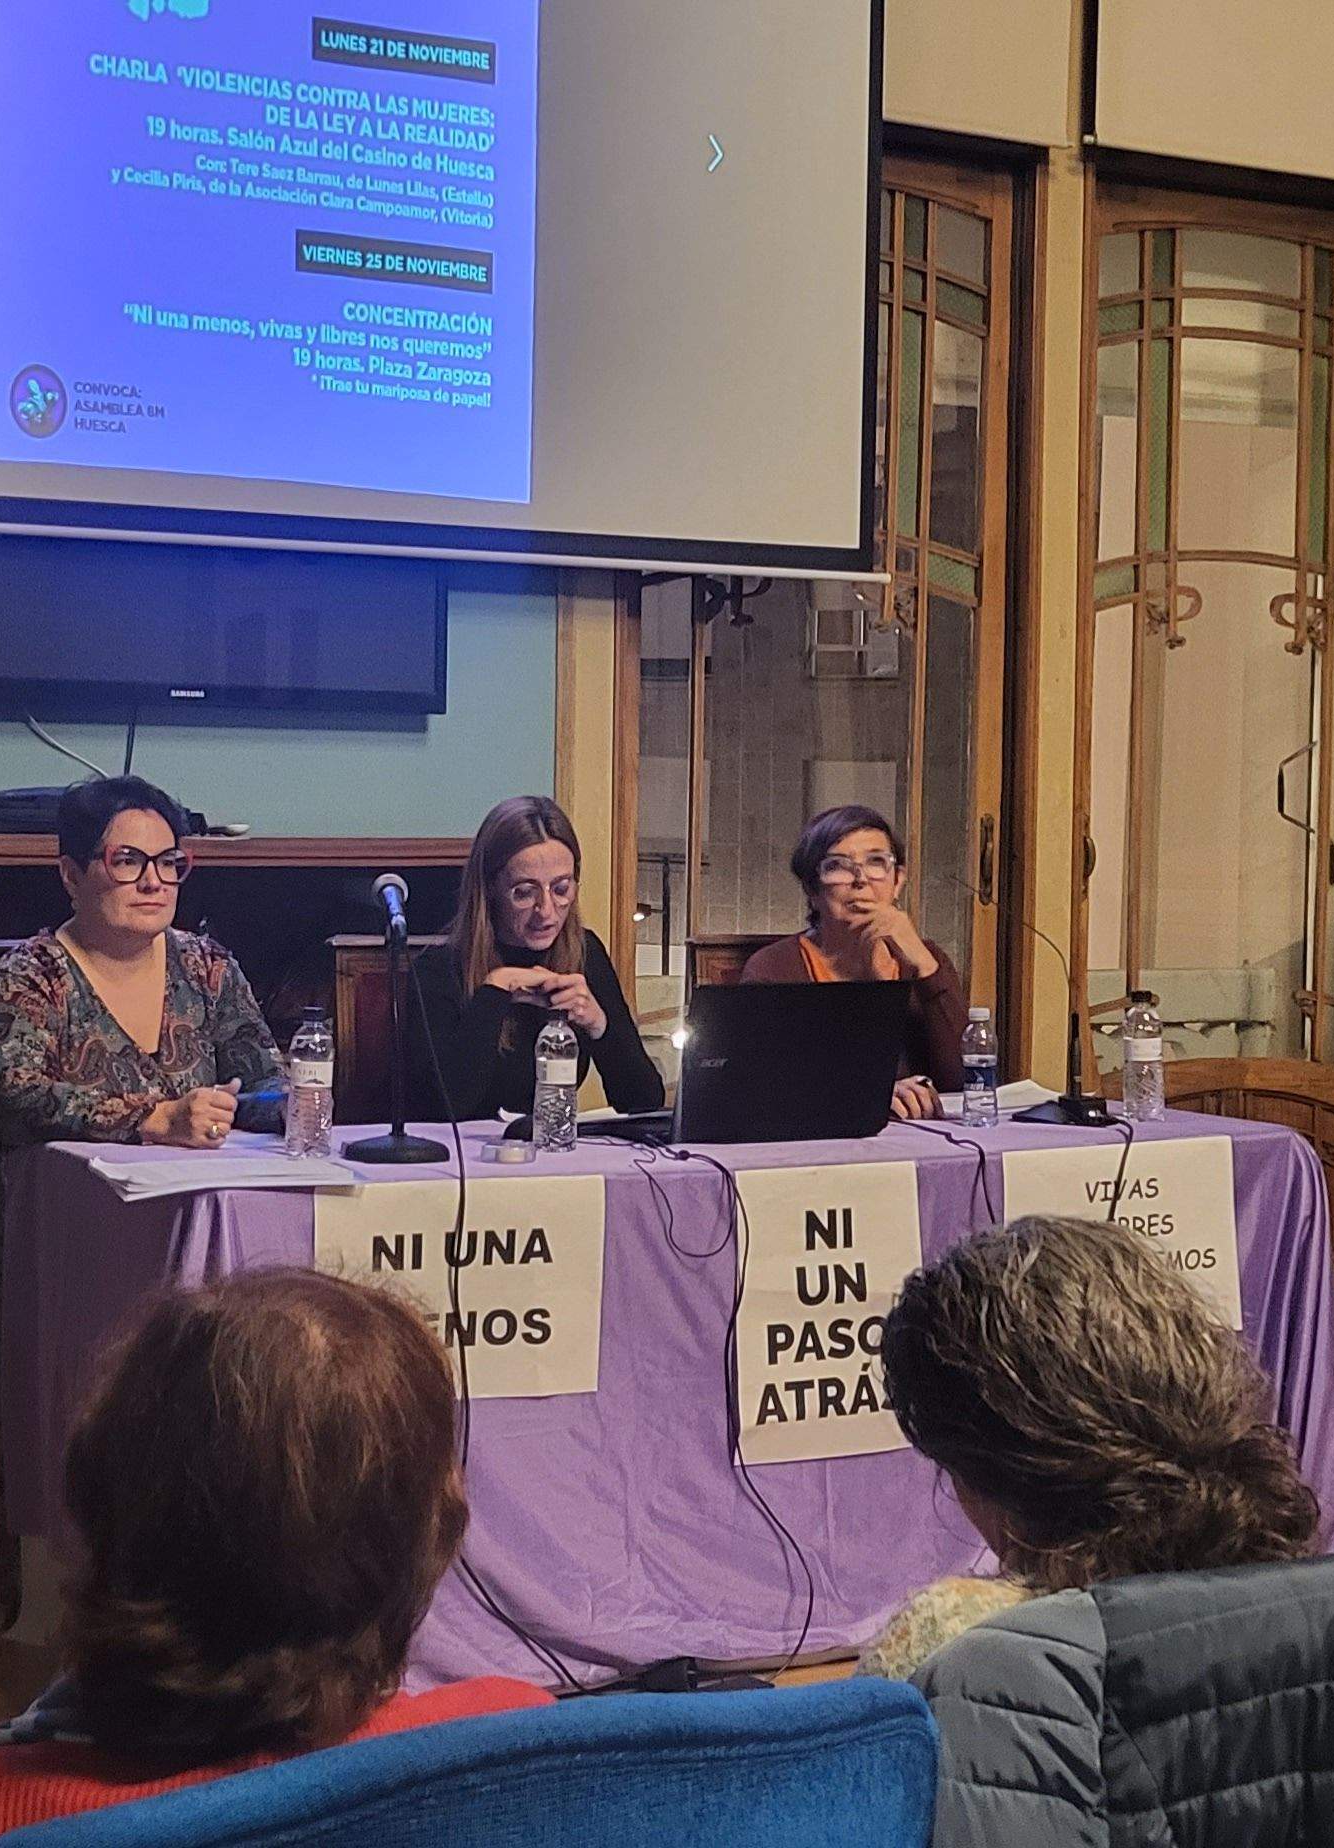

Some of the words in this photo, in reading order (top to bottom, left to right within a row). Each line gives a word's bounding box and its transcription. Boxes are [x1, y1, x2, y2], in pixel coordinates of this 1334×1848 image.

[321, 30, 367, 53] LUNES
[369, 38, 384, 55] 21
[387, 41, 406, 58] DE
[409, 43, 490, 69] NOVIEMBRE
[90, 54, 167, 83] CHARLA
[296, 83, 371, 111] CONTRA
[376, 92, 408, 116] LAS
[413, 97, 494, 127] MUJERES:
[266, 103, 291, 126] DE
[295, 107, 318, 131] LA
[323, 112, 356, 135] LEY
[360, 120, 373, 137] A
[377, 122, 400, 142] LA
[147, 115, 165, 136] 19
[171, 119, 223, 145] horas.
[228, 126, 275, 151] Salón
[280, 134, 317, 157] Azul
[322, 140, 348, 161] del
[352, 143, 407, 168] Casino
[411, 150, 432, 170] de
[436, 153, 494, 181] Huesca
[111, 168, 120, 183] y
[209, 178, 226, 194] de
[229, 179, 241, 196] la
[245, 181, 316, 205] Asociación
[320, 191, 353, 210] Clara
[357, 196, 438, 223] Campoamor,
[441, 207, 493, 229] (Vitoria)
[347, 174, 363, 189] de
[367, 176, 403, 195] Lunes
[442, 186, 494, 209] (Estella)
[302, 245, 363, 266] VIERNES
[366, 253, 382, 269] 25
[385, 255, 404, 271] DE
[406, 258, 487, 283] NOVIEMBRE
[156, 309, 189, 330] una
[193, 314, 255, 340] menos,
[259, 319, 303, 340] vivas
[306, 327, 316, 345] y
[321, 323, 366, 346] libres
[370, 334, 399, 351] nos
[343, 302, 492, 336] CONCENTRACIÓN
[293, 347, 311, 366] 19
[315, 350, 364, 373] horas.
[369, 355, 412, 378] Plaza
[417, 361, 491, 387] Zaragoza
[74, 381, 142, 399] CONVOCA:
[74, 400, 144, 417] ASAMBLEA
[355, 380, 369, 394] tu
[372, 384, 430, 403] mariposa
[434, 388, 449, 403] de
[452, 391, 491, 408] papel!
[74, 418, 126, 433] HUESCA
[1085, 1178, 1160, 1203] VIVAS
[805, 1208, 853, 1251] NI
[372, 1232, 423, 1272] NI
[445, 1227, 553, 1267] UNA
[796, 1262, 867, 1306] UN
[766, 1315, 887, 1366] PASO
[756, 1362, 896, 1426] ATRÁ
